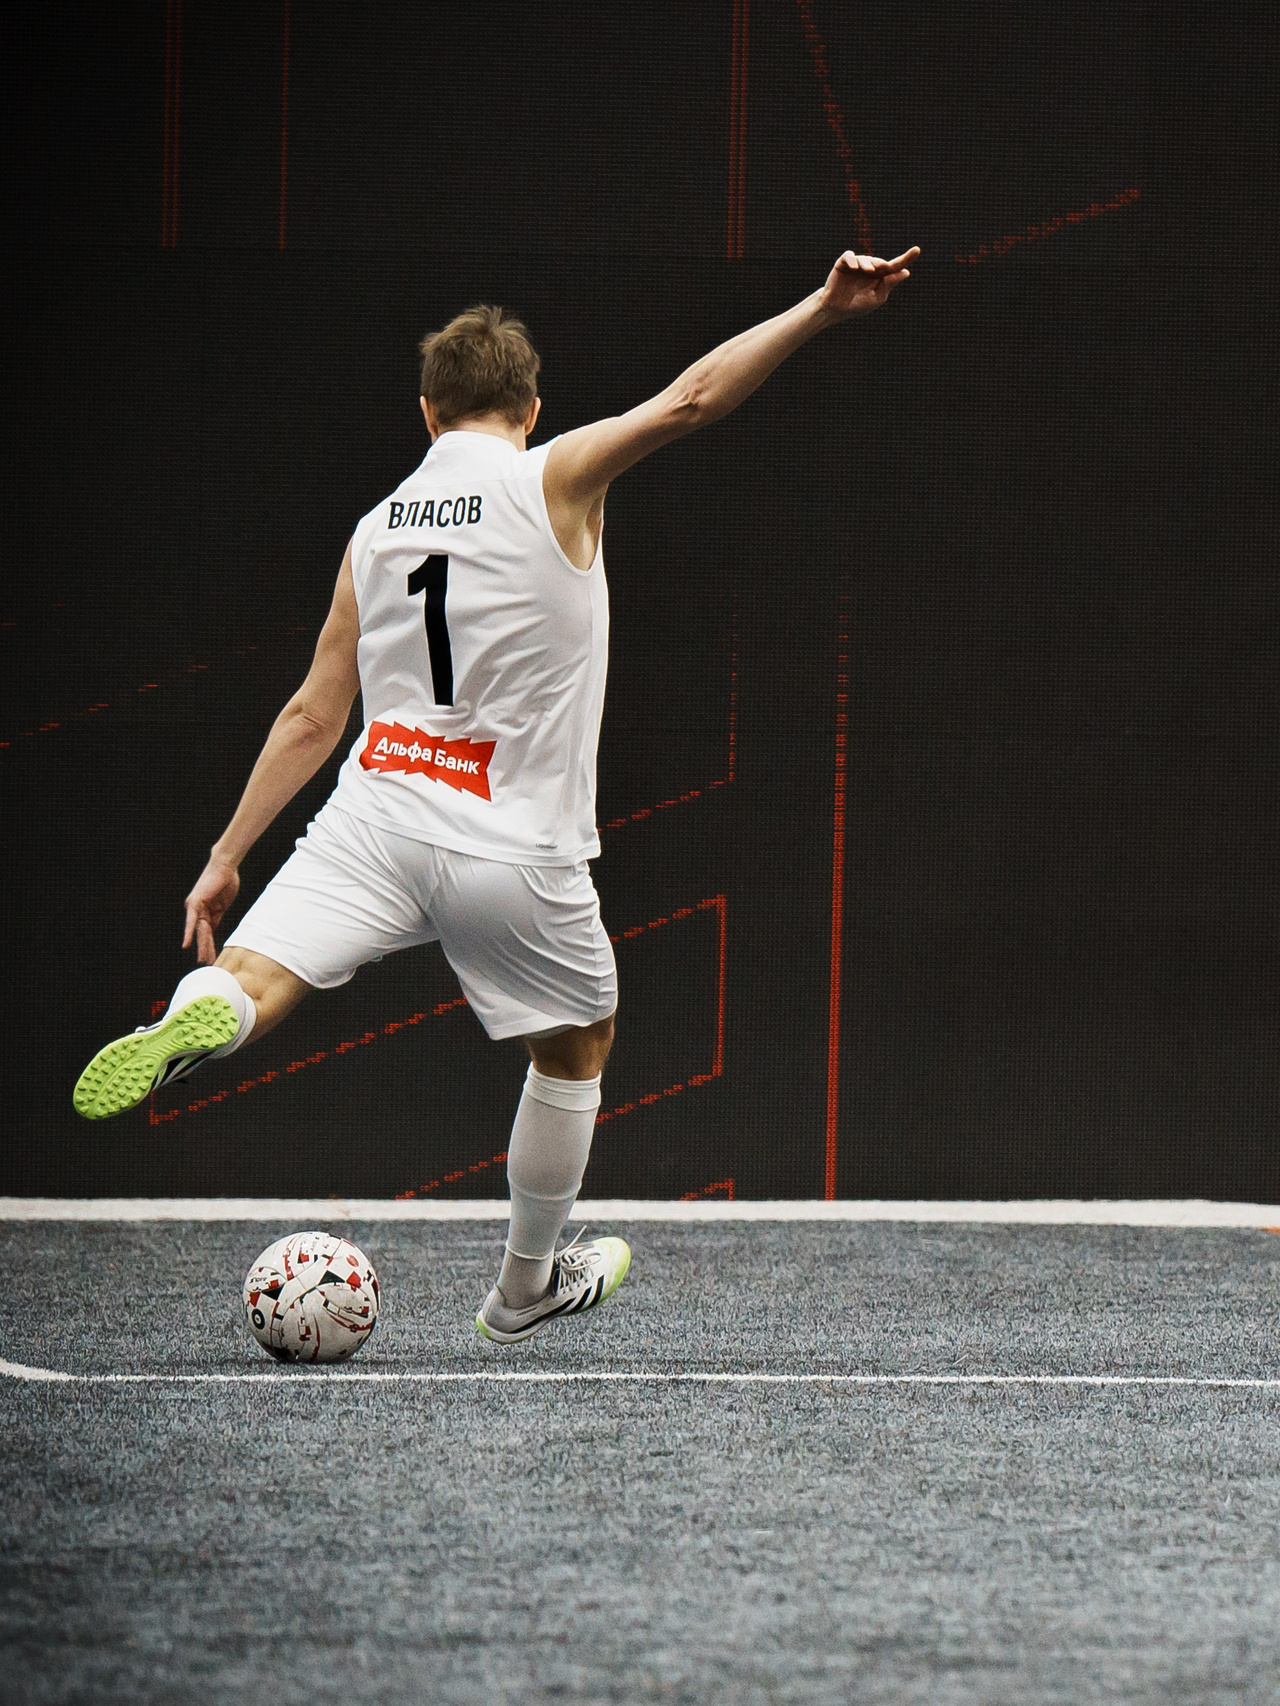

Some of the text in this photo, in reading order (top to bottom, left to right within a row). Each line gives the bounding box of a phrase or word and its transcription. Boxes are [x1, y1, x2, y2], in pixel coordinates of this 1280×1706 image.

[387, 495, 482, 529] ВЛАСОВ
[408, 554, 454, 706] 1
[371, 736, 480, 774] Альфа Банк
